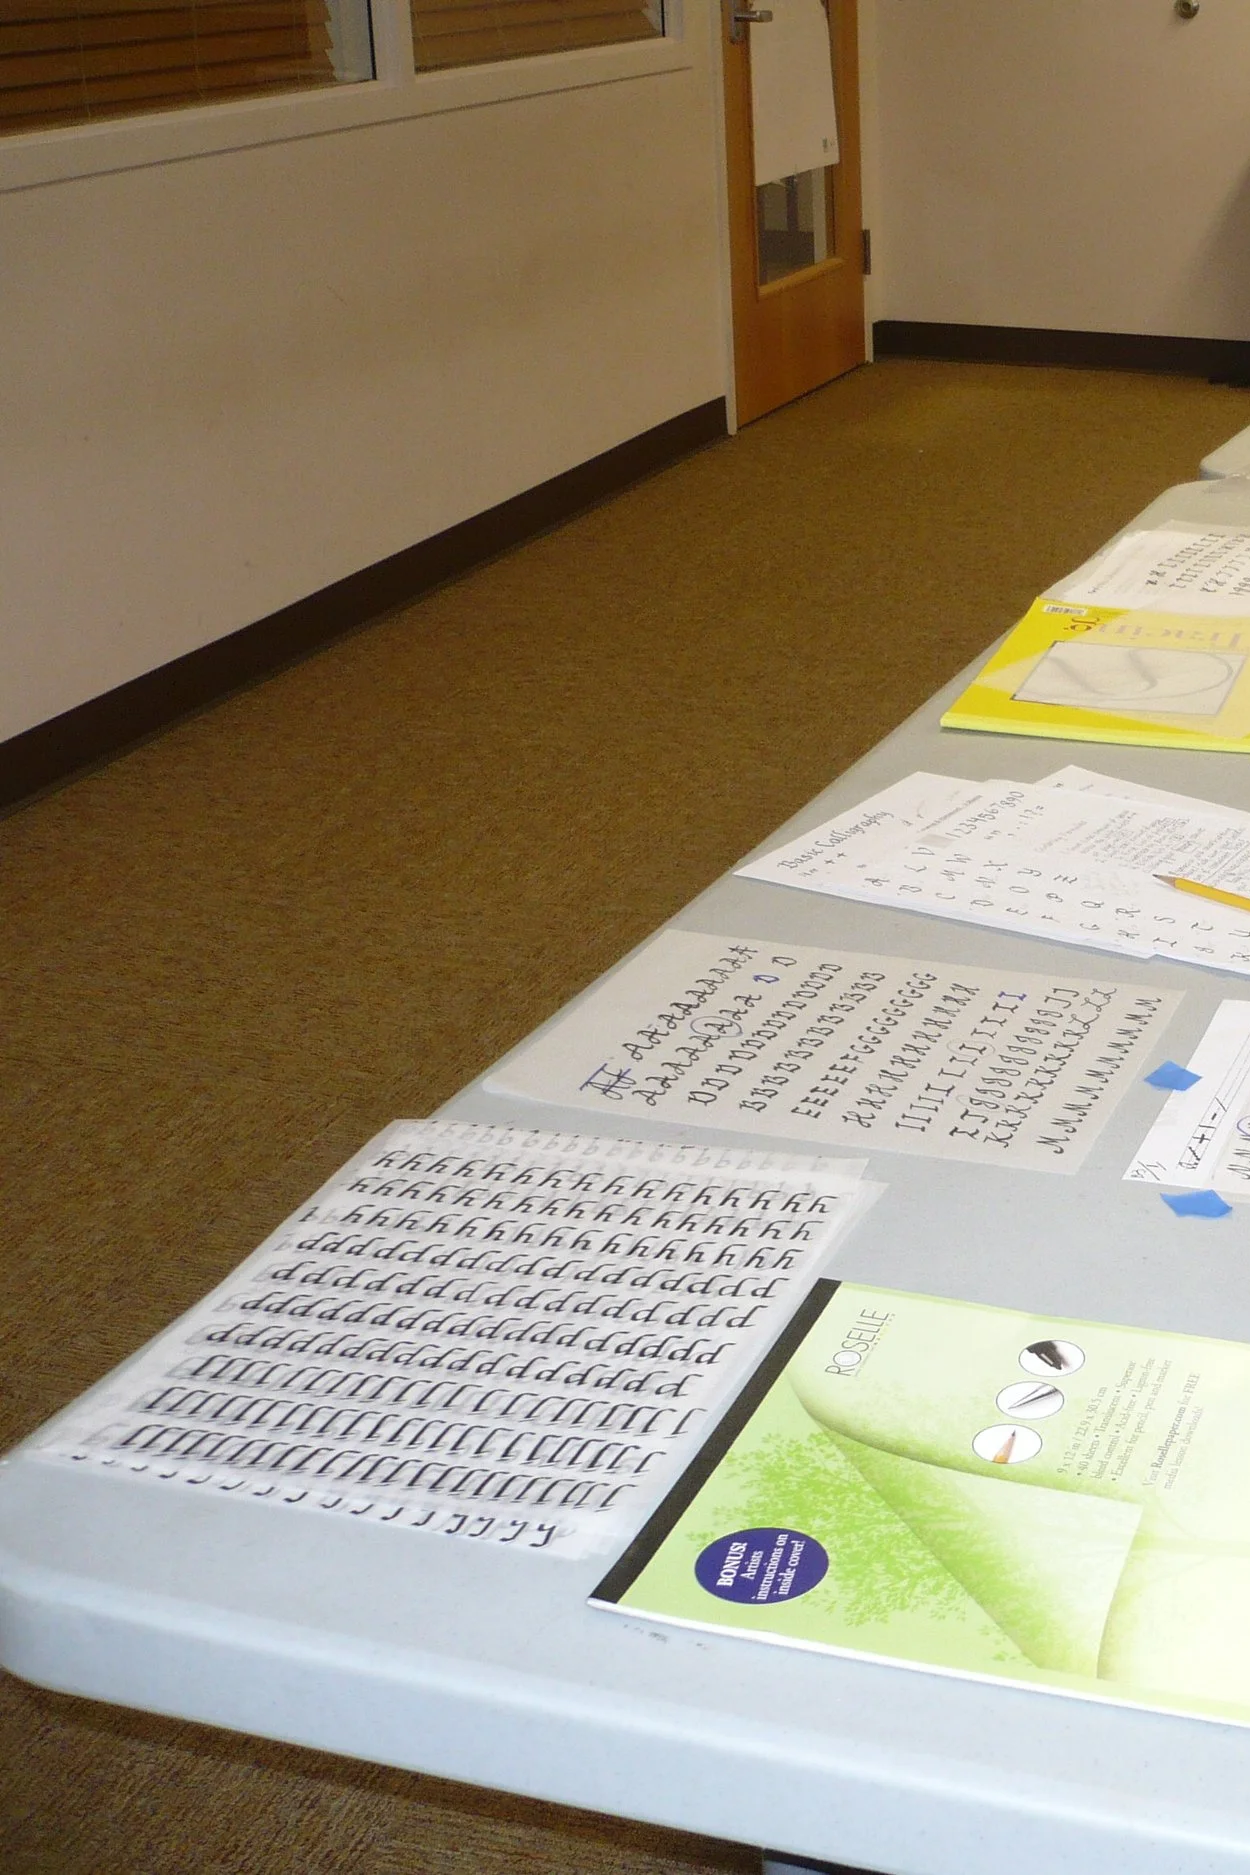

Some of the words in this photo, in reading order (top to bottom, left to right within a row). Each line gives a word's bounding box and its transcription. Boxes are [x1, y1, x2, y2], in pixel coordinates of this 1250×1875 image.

[777, 848, 824, 870] Basic
[815, 810, 894, 848] Calligraphy
[824, 1309, 890, 1377] ROSELLE
[1150, 1406, 1187, 1469] Rosellepaper.com
[716, 1542, 748, 1587] BONUS!
[740, 1550, 764, 1580] Artists
[751, 1547, 785, 1601] instructions
[775, 1534, 789, 1546] on
[772, 1568, 797, 1596] inside
[788, 1540, 806, 1568] cover!
